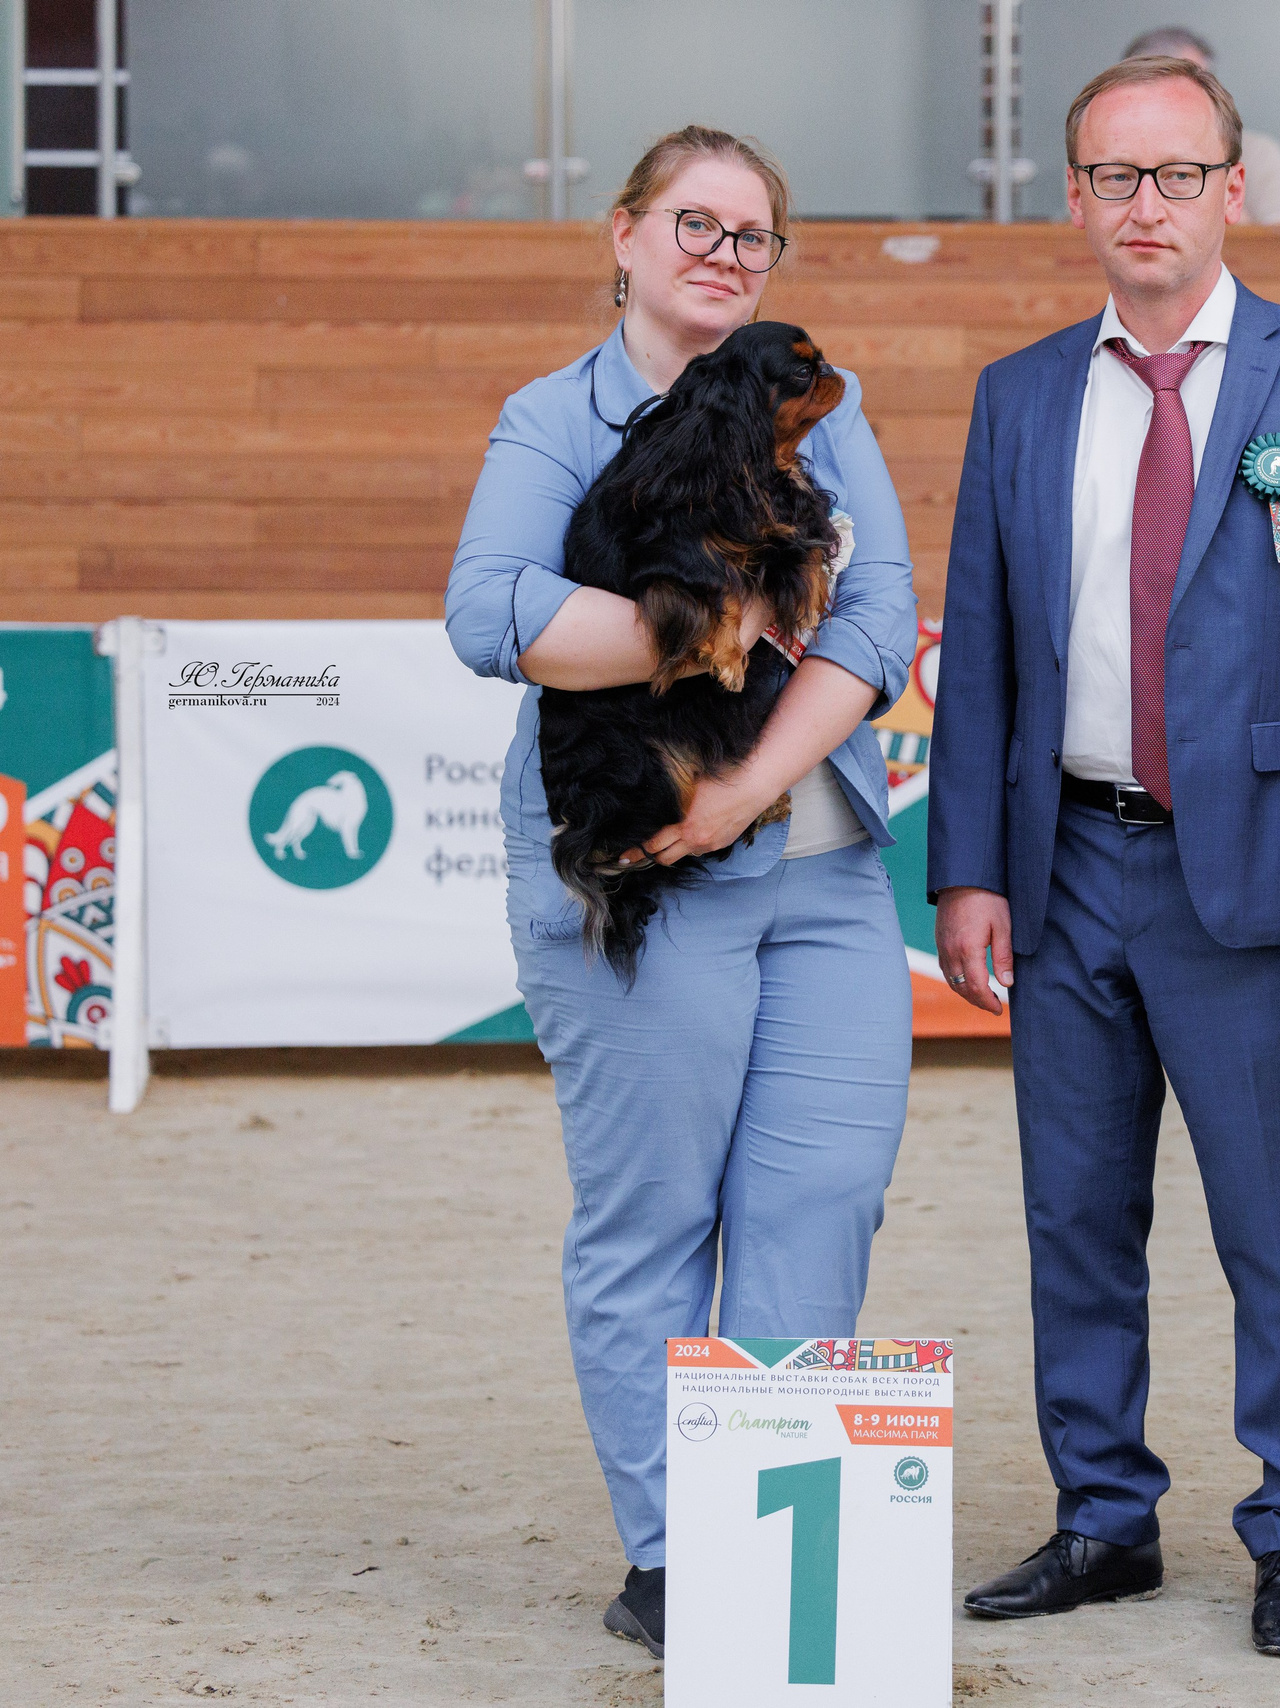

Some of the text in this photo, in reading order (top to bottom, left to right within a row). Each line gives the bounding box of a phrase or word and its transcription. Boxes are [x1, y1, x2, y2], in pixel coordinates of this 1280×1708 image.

[675, 1344, 710, 1358] 2024
[674, 1372, 940, 1387] НАЦИОНАЛЬНЫЕ ВЫСТАВКИ СОБАК ВСЕХ ПОРОД
[682, 1384, 933, 1398] НАЦИОНАЛЬНЫЕ МОНОПОРОДНЫЕ ВЫСТАВКИ
[727, 1409, 813, 1436] Champion
[853, 1413, 940, 1428] 8-9 ИЮНЯ
[780, 1431, 808, 1439] NATURE
[853, 1429, 939, 1440] МАКСИМА ПАРК
[890, 1494, 932, 1504] РОССИЯ
[757, 1456, 842, 1685] 1
